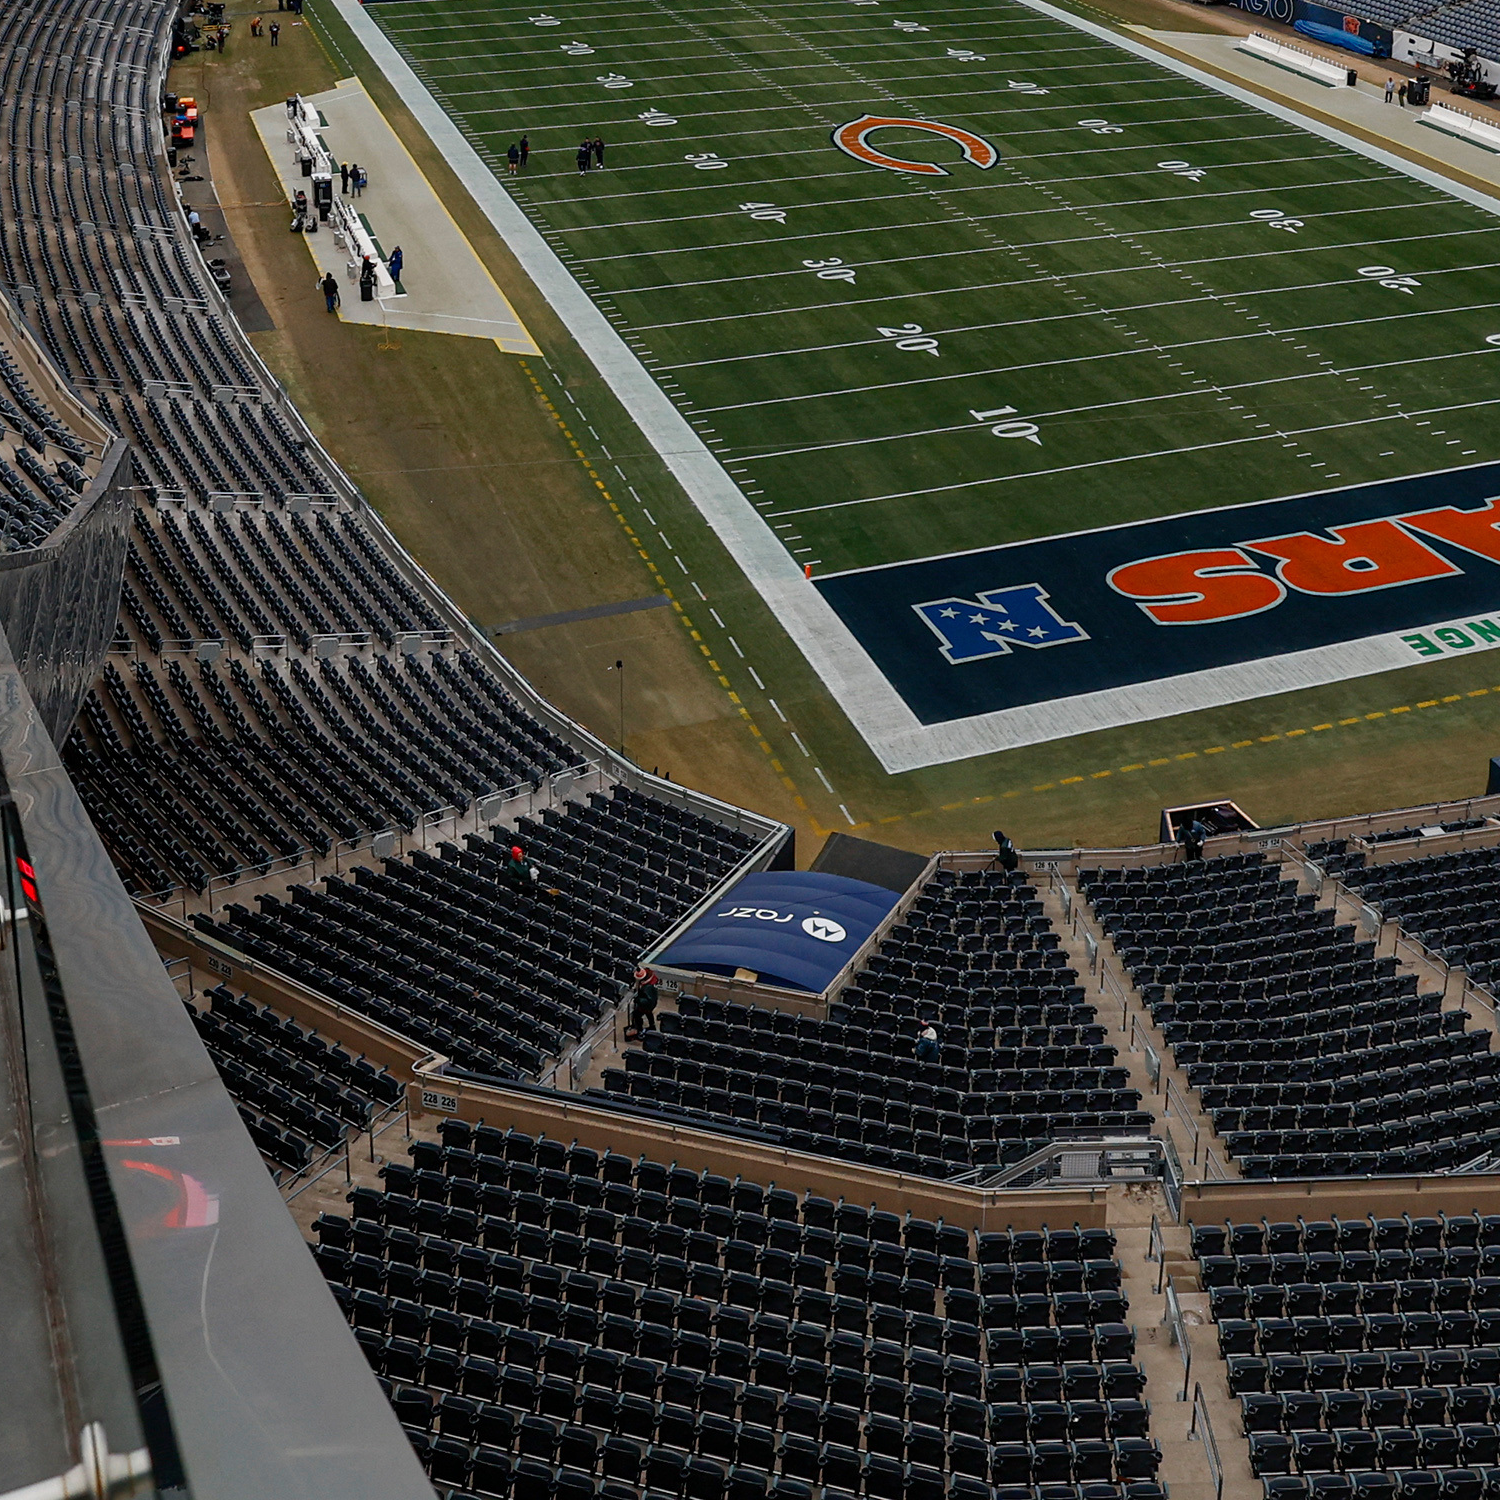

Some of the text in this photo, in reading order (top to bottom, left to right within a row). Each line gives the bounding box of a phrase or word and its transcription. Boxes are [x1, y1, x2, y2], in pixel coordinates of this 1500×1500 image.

[596, 75, 634, 89] 30
[1008, 81, 1051, 95] 40
[638, 110, 678, 127] 40
[1077, 119, 1125, 135] 50
[830, 113, 1000, 177] C
[684, 153, 729, 171] 50
[1157, 160, 1207, 179] 40
[738, 202, 788, 221] 40
[1249, 209, 1305, 230] 30
[802, 256, 856, 280] 30
[1357, 265, 1422, 290] 20
[876, 323, 939, 352] 20
[969, 405, 1040, 438] 10
[717, 906, 795, 924] razr
[423, 1091, 457, 1108] 228 226
